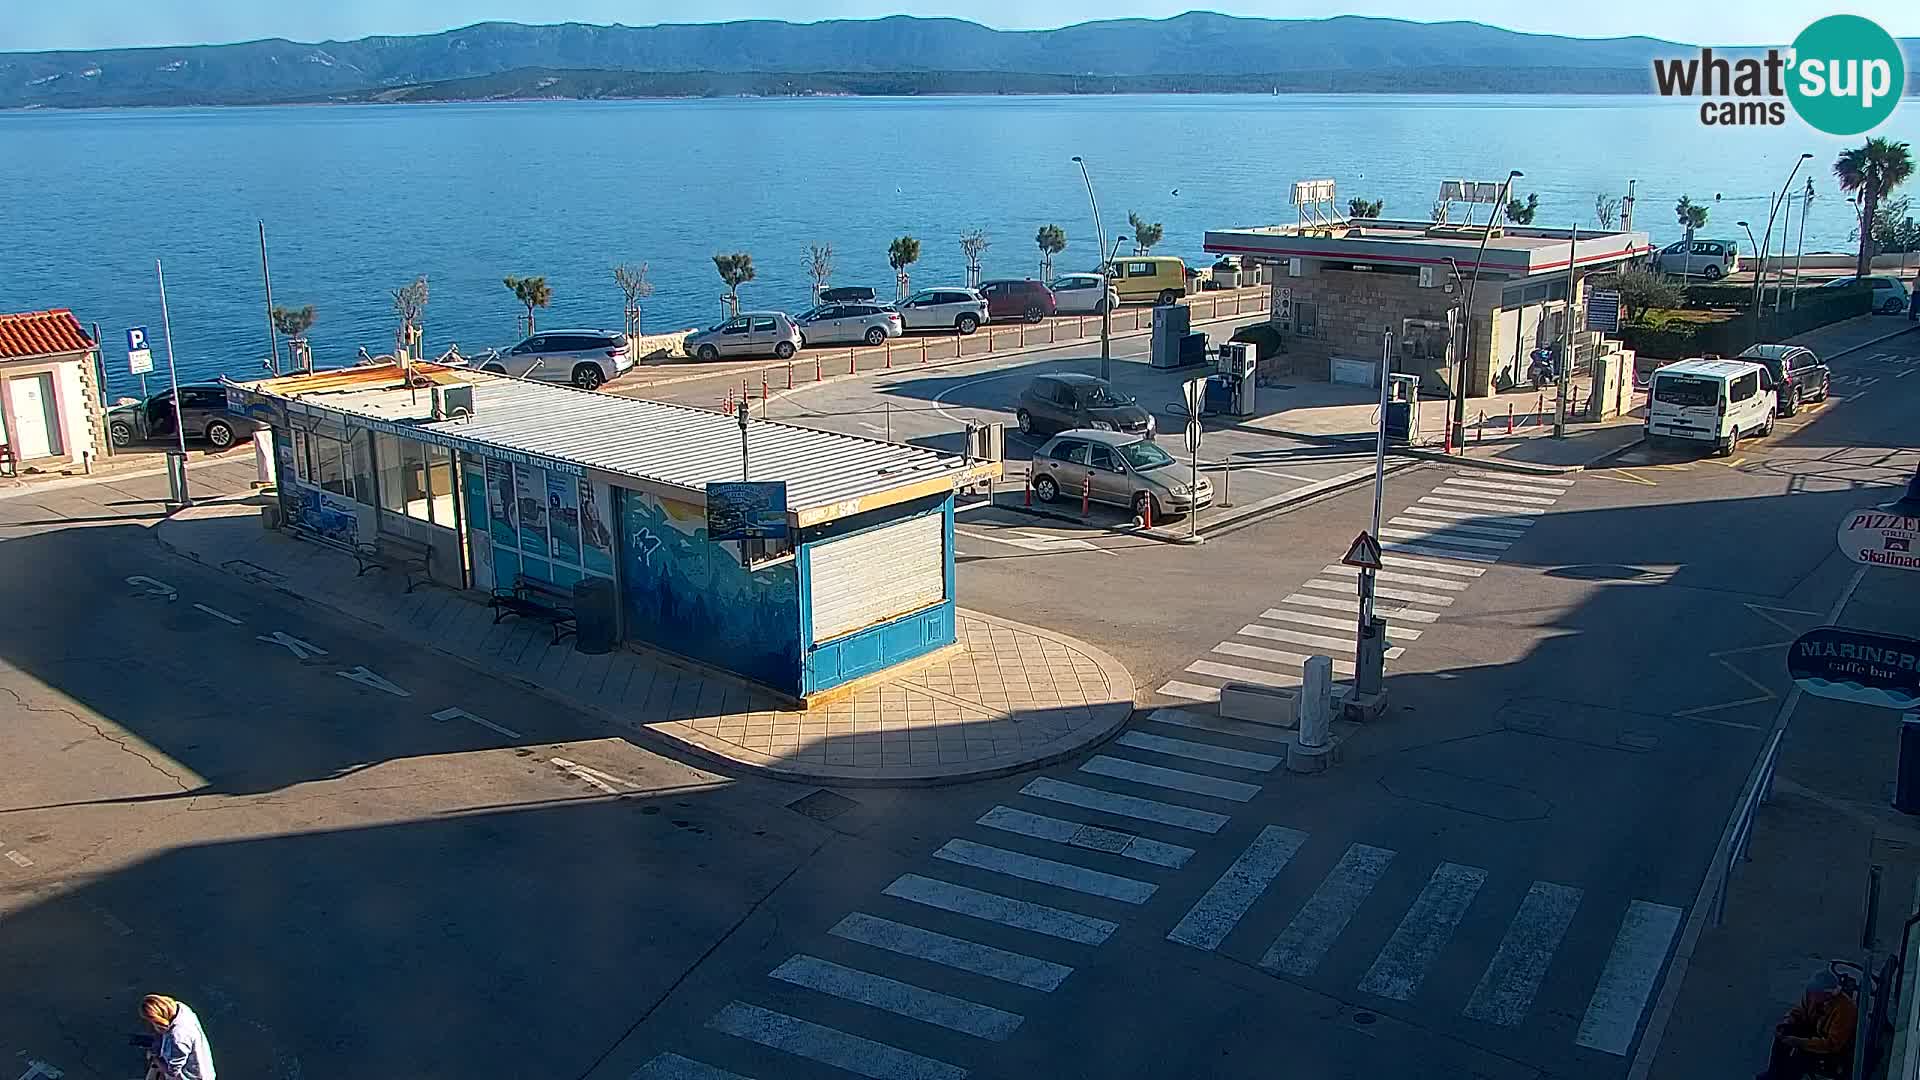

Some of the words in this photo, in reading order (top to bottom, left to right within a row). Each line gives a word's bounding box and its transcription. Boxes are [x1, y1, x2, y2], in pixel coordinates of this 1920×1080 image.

[130, 330, 144, 349] P
[1830, 374, 1880, 388] AXI
[480, 446, 494, 457] BUS
[495, 448, 527, 464] STATION
[529, 456, 555, 470] TICKET
[556, 463, 583, 476] OFFICE
[1848, 513, 1920, 531] PIZZE
[1881, 530, 1917, 540] GRILL
[1828, 661, 1865, 674] caffe
[1870, 664, 1897, 680] bar
